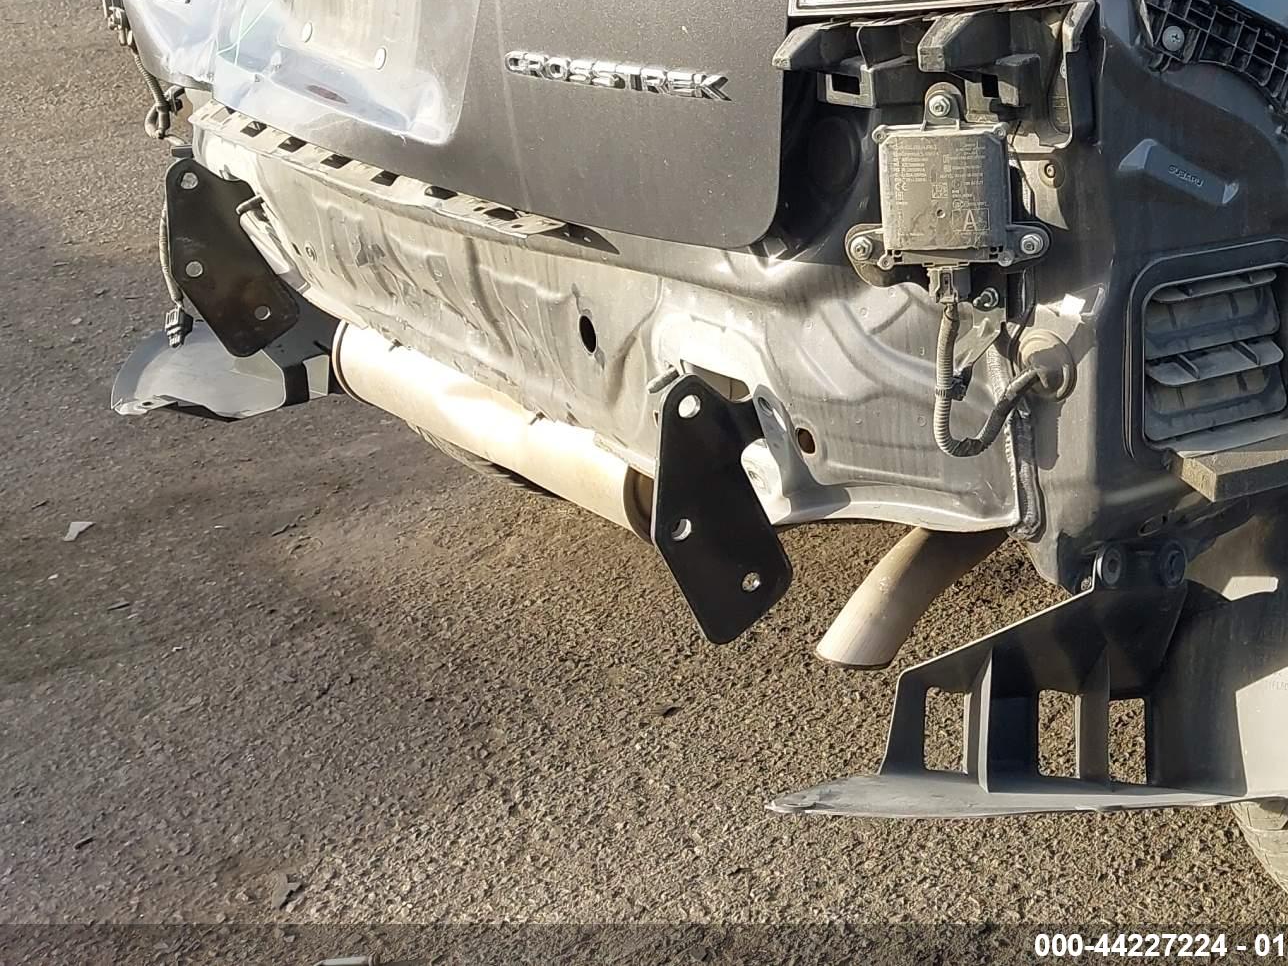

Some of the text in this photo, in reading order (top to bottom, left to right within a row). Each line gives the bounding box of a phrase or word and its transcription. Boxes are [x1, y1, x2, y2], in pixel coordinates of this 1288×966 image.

[504, 49, 733, 102] CROSSTREK
[1168, 164, 1205, 187] SUBARU
[962, 208, 978, 232] A
